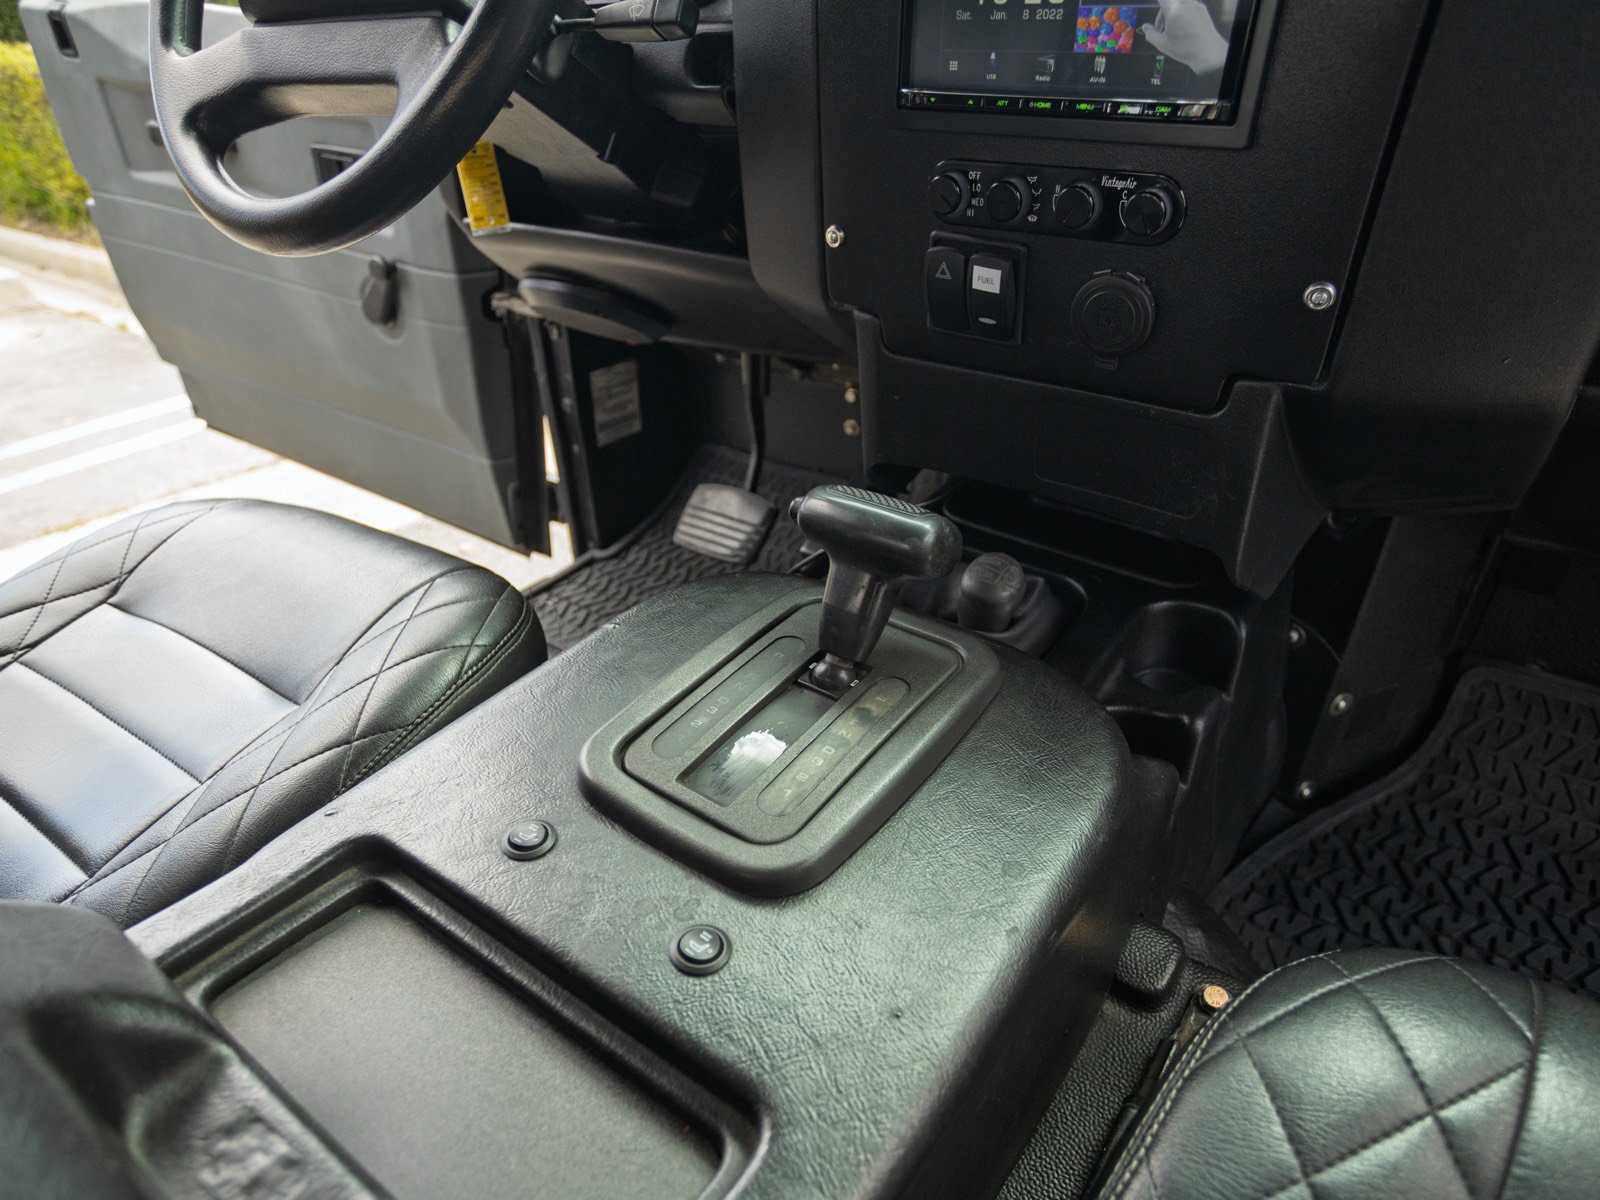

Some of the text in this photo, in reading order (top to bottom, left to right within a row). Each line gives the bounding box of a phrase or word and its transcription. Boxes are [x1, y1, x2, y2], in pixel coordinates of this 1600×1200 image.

[955, 9, 1064, 20] Sat. Jan. 8 2022
[1035, 74, 1051, 82] Radio
[1033, 101, 1052, 109] HOME
[968, 171, 981, 180] OFF
[972, 183, 981, 192] LO
[1055, 184, 1061, 194] H
[1122, 190, 1128, 200] C
[971, 197, 984, 207] MED
[977, 275, 995, 286] FUEL
[706, 705, 719, 714] 3
[820, 745, 836, 755] D
[810, 756, 825, 767] 3
[795, 771, 809, 782] 2
